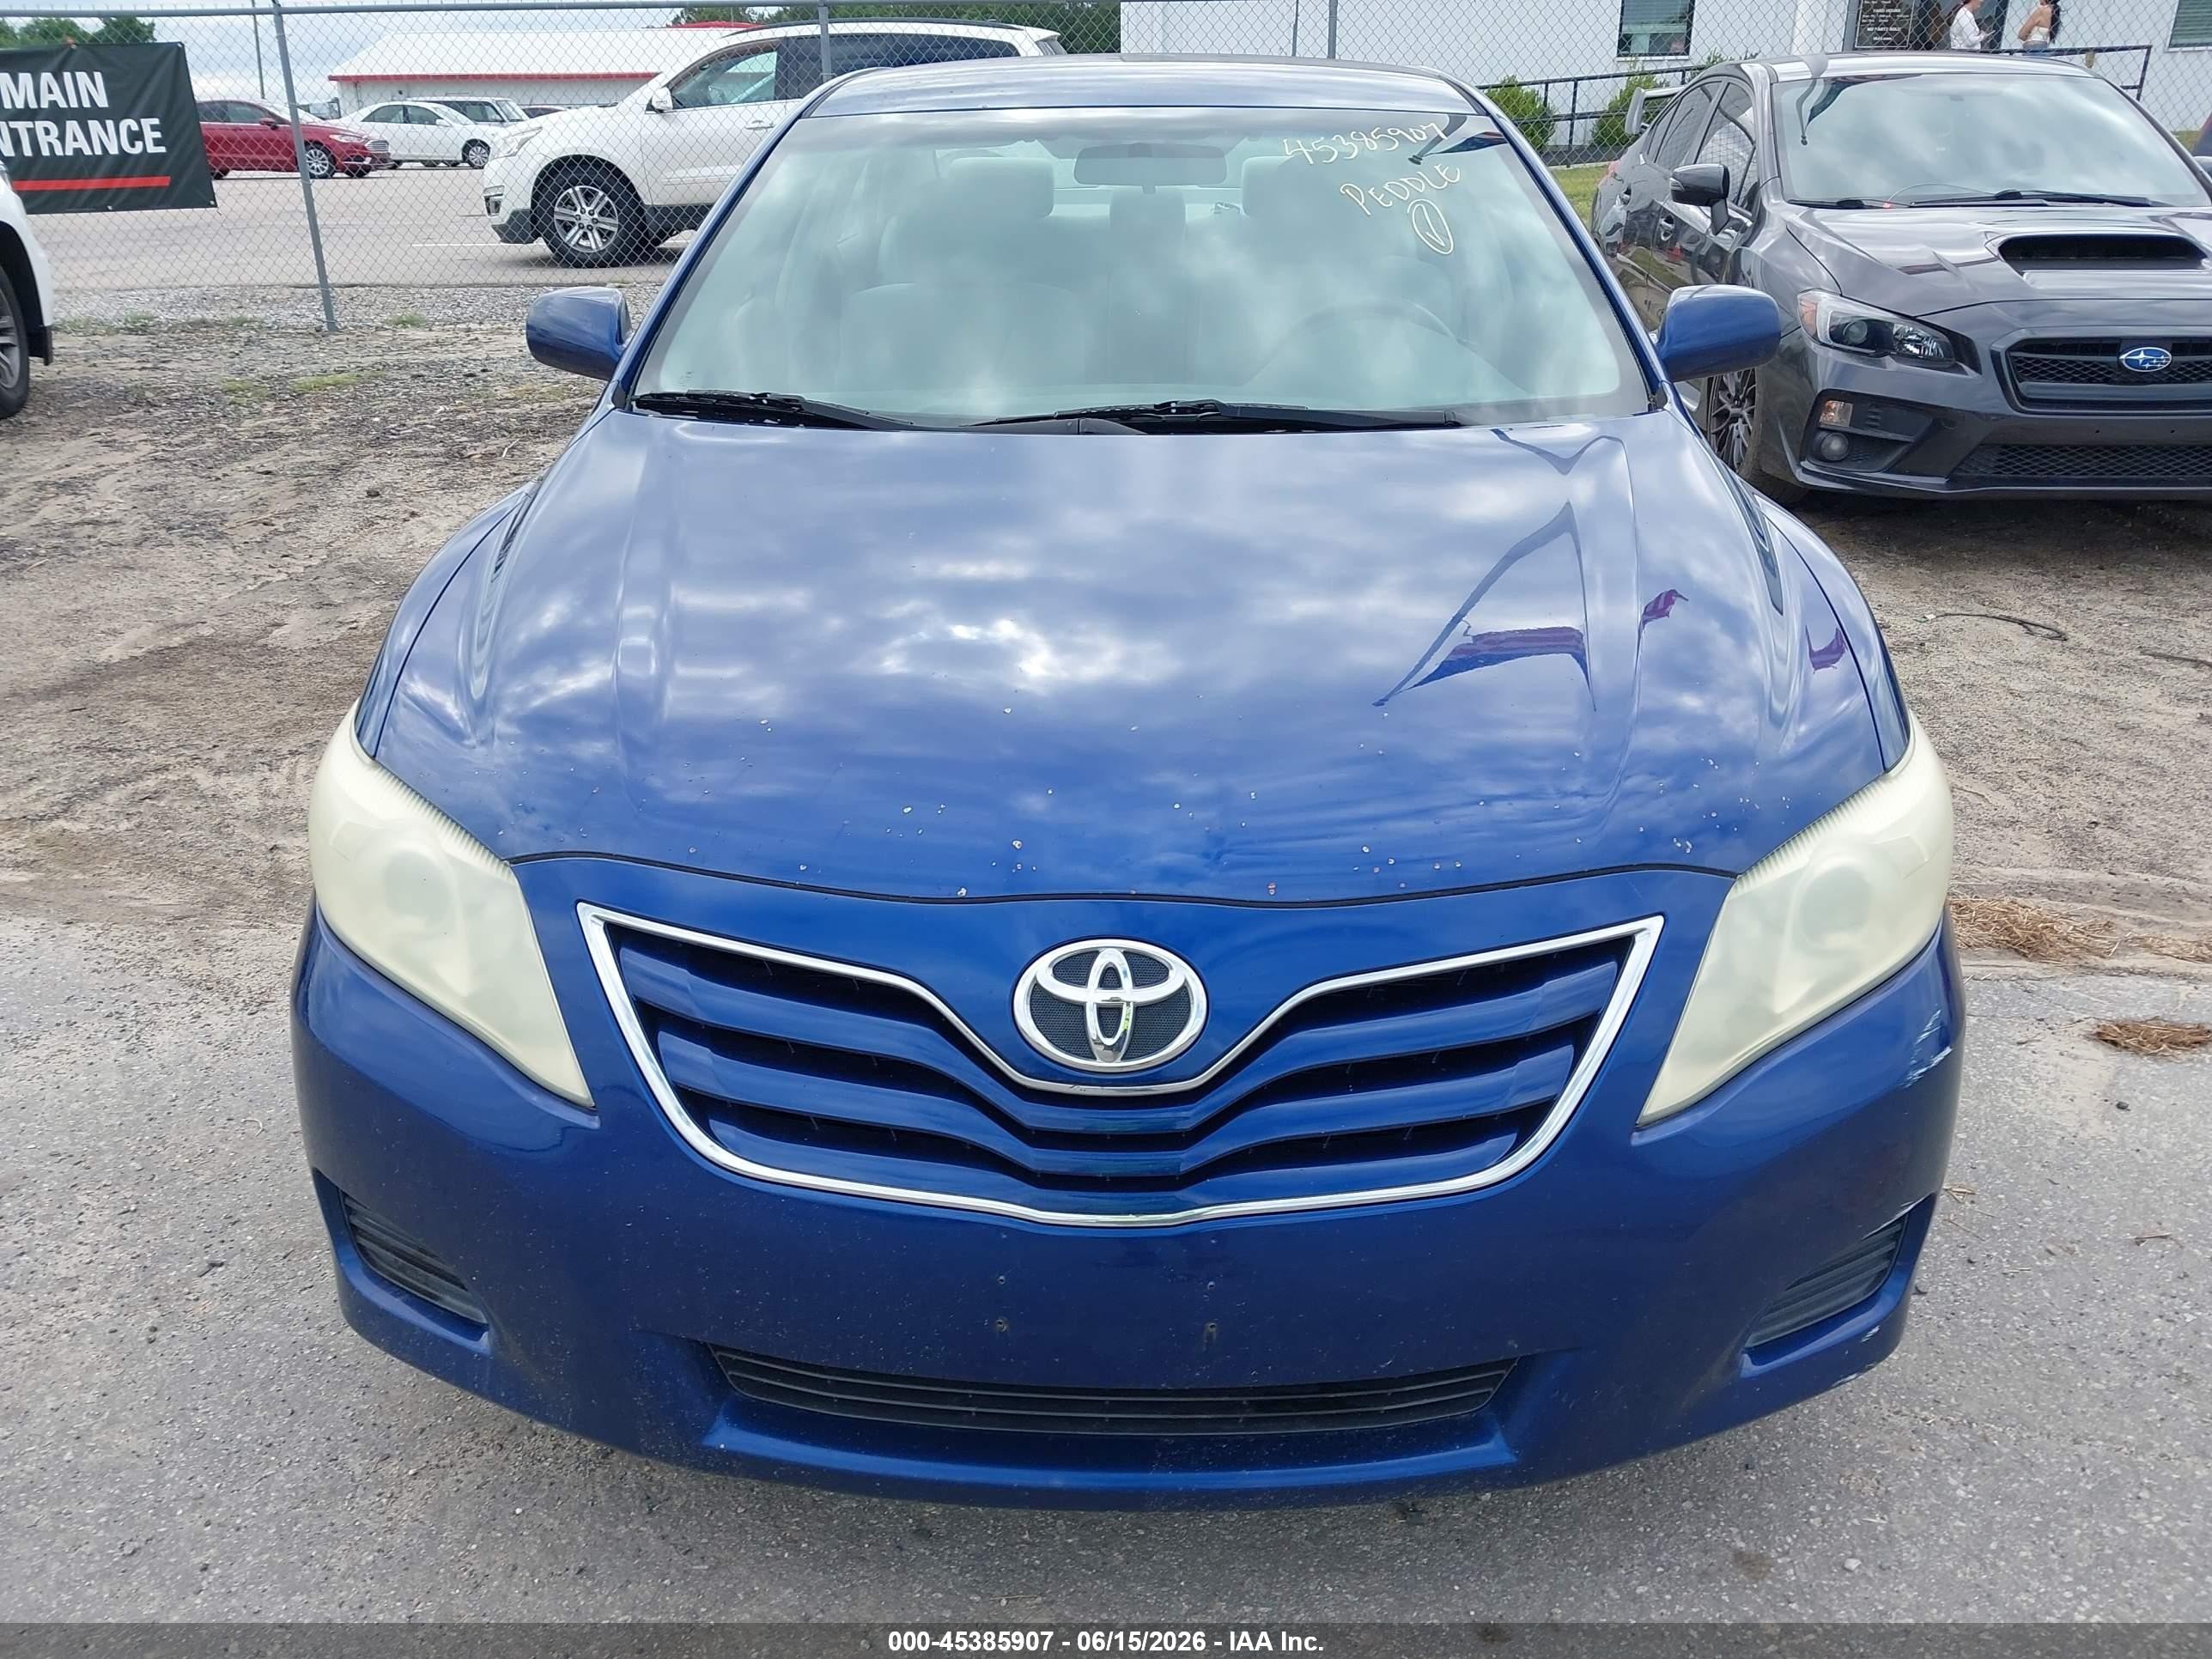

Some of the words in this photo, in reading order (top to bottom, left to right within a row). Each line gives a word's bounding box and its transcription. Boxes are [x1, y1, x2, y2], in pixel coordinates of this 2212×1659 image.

[0, 71, 109, 109] MAIN
[1284, 123, 1449, 164] 45385907
[1340, 164, 1461, 216] PEDDLE
